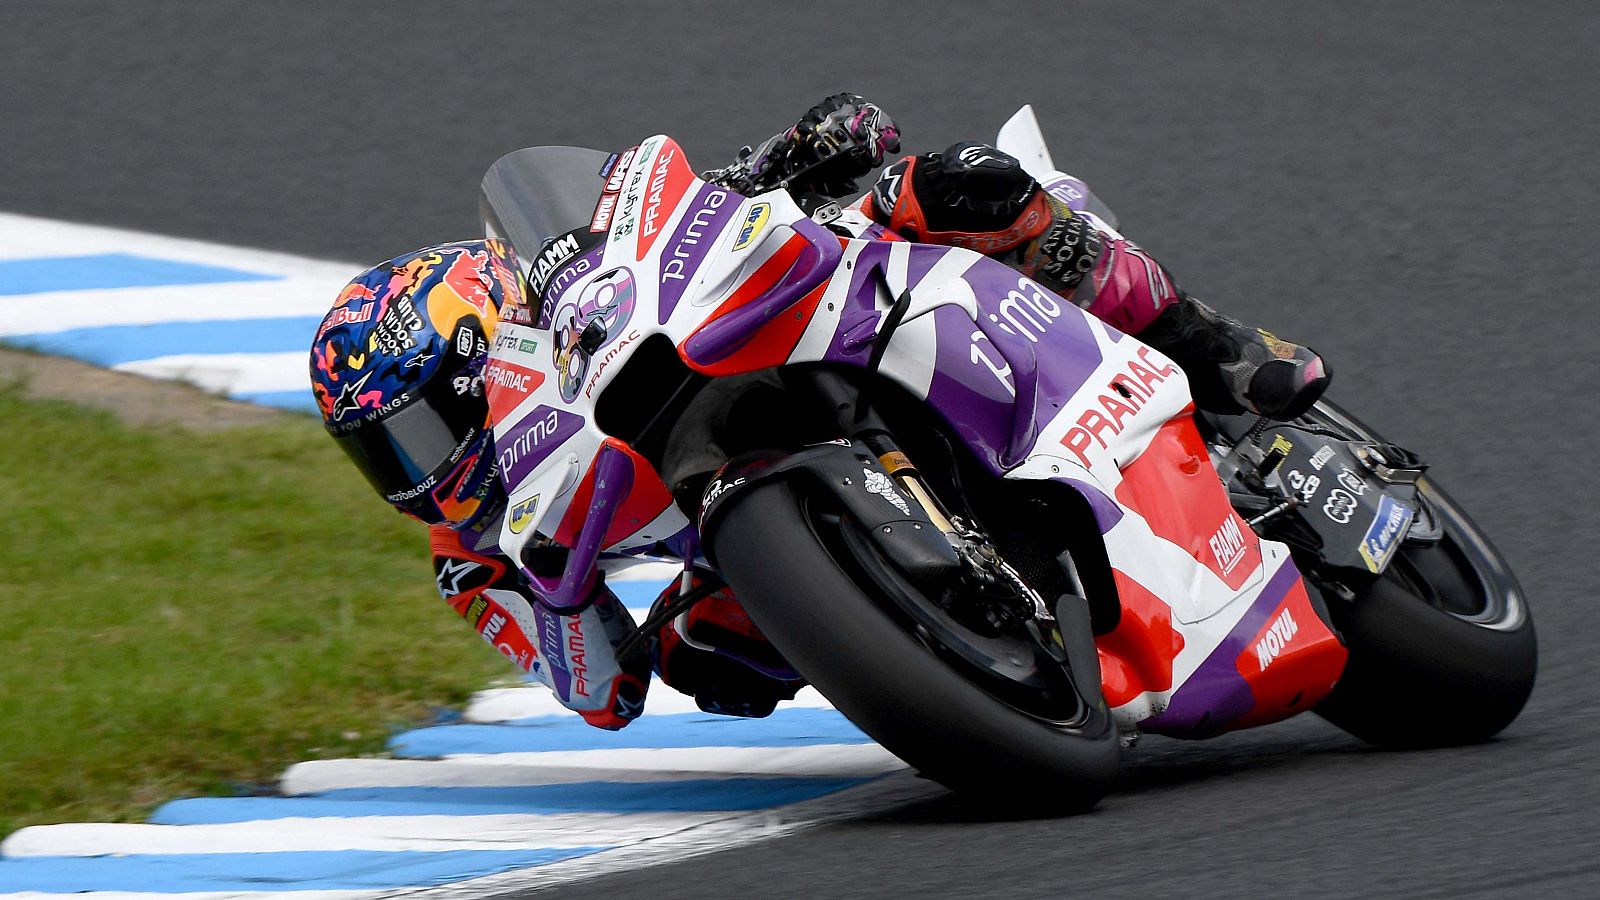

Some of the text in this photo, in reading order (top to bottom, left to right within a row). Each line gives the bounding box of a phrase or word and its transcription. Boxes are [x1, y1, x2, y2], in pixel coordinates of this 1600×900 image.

[593, 195, 616, 231] MOTUL
[643, 149, 675, 238] PRAMAC
[529, 233, 580, 296] FIAMM
[661, 189, 730, 284] prima
[397, 296, 422, 331] CLUB
[543, 258, 591, 321] prima
[384, 307, 414, 350] SOCIAL
[486, 364, 532, 394] PRAMAC
[585, 328, 641, 399] PRAMAC
[365, 392, 410, 422] WINGS
[1059, 345, 1174, 470] PRAMAC
[499, 410, 558, 484] prima
[1208, 513, 1245, 570] FIAMM
[1256, 607, 1299, 672] MOTUL
